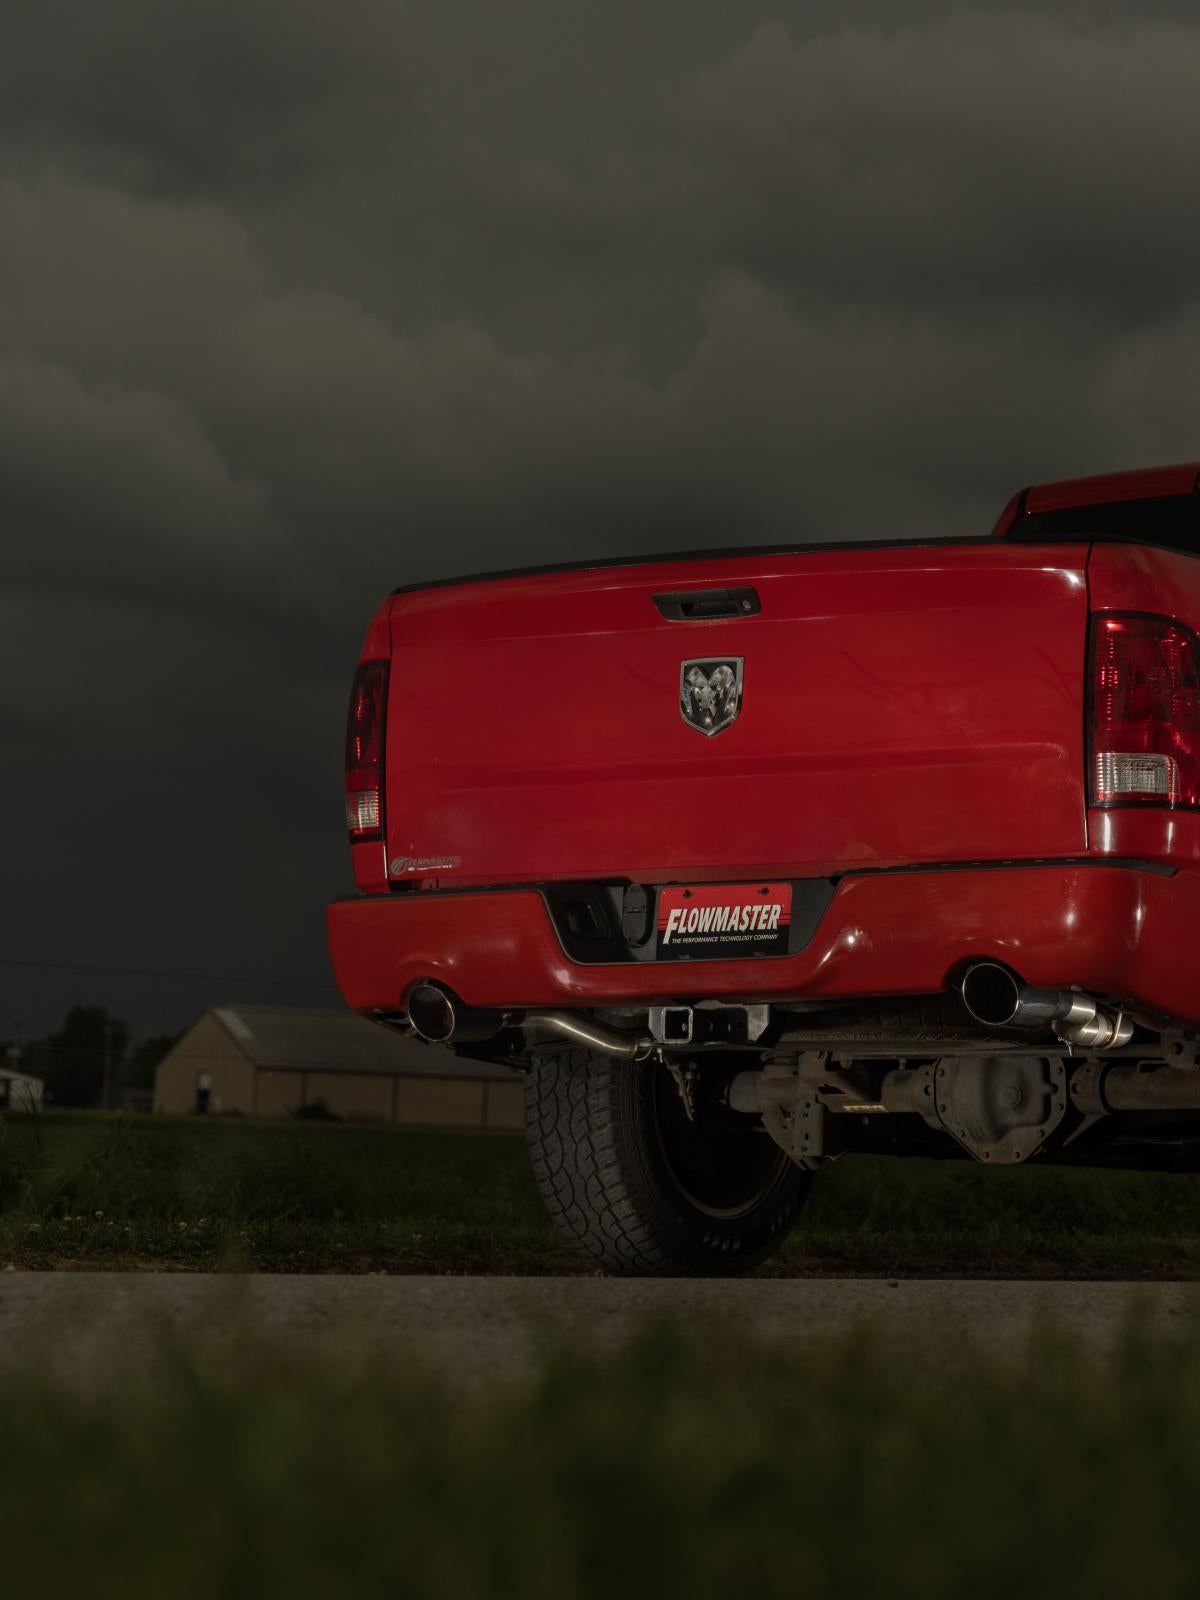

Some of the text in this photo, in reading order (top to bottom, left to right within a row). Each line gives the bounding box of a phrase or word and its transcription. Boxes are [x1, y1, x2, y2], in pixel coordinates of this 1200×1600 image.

[662, 904, 781, 945] FLOWMASTER
[682, 936, 718, 944] PERFORMANCE
[719, 934, 753, 942] TECHNOLOGY
